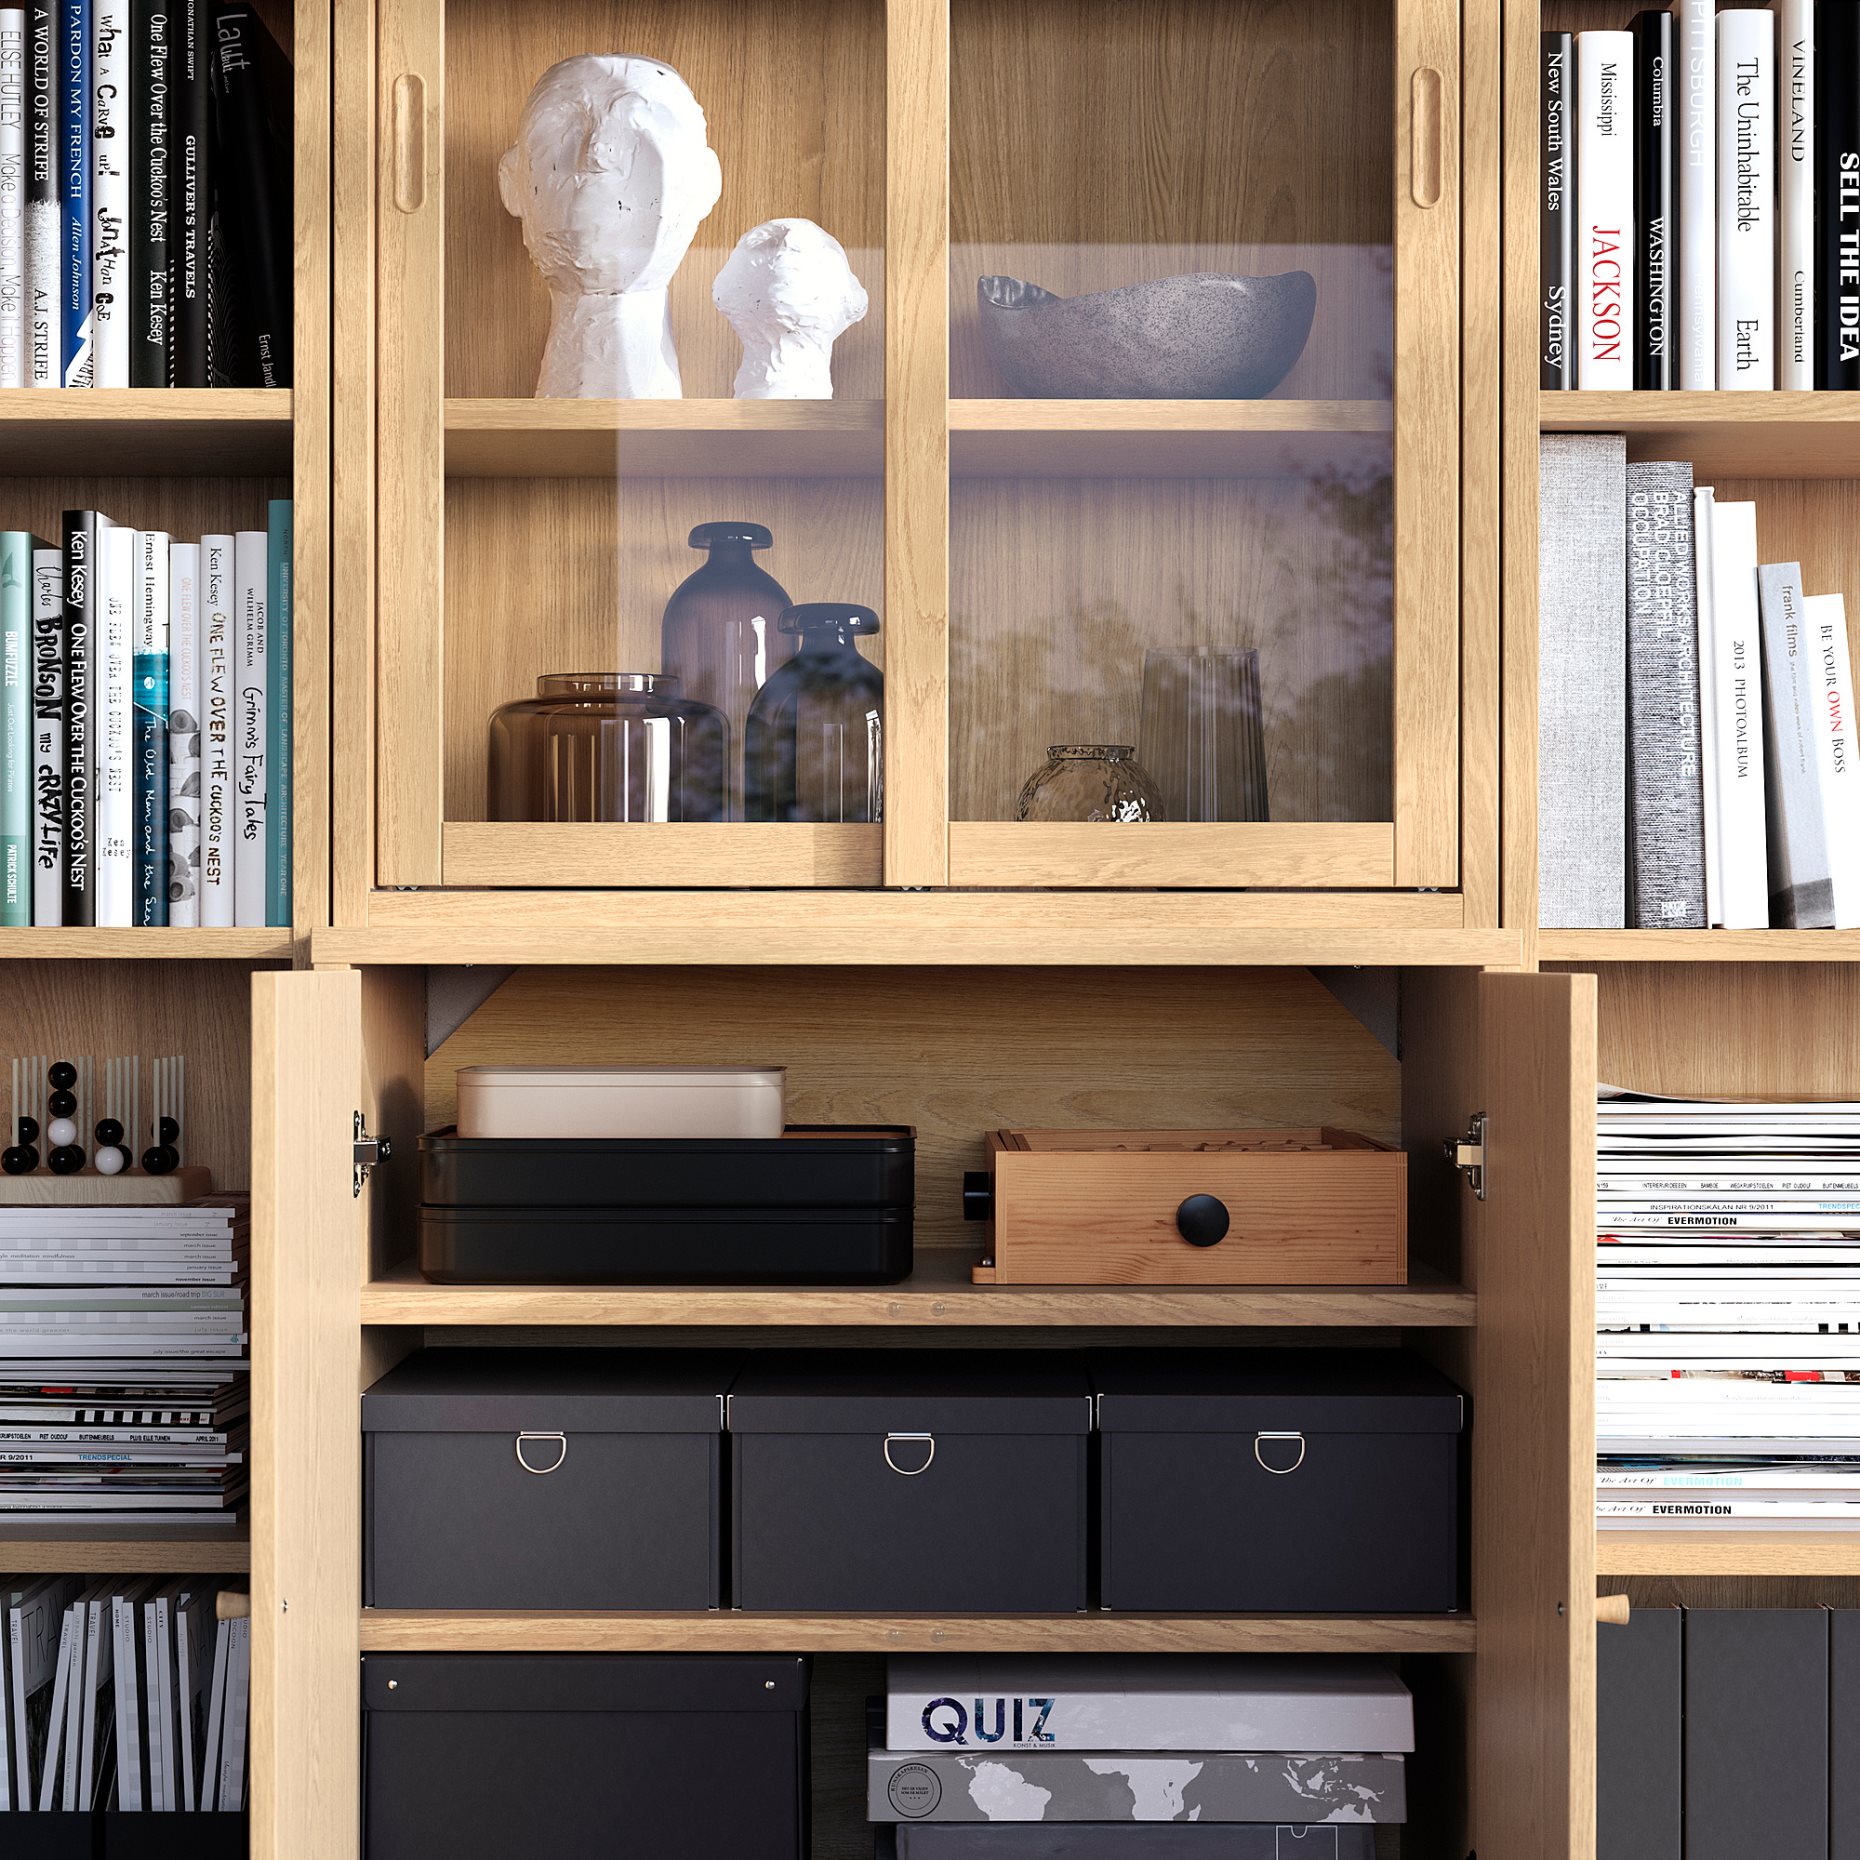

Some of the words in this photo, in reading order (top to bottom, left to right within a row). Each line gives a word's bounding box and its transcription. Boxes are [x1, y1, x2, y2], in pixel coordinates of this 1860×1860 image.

[35, 8, 48, 20] A
[151, 15, 167, 41] One
[1, 32, 22, 69] ELISE
[35, 25, 48, 89] WORLD
[71, 6, 81, 82] PARDON
[216, 14, 251, 69] Laut
[151, 45, 167, 80] Flew
[1549, 51, 1563, 96] New
[1737, 58, 1759, 95] The
[1, 72, 22, 129] HUTLEY
[151, 84, 166, 119] Over
[1597, 64, 1616, 135] Mississippi
[1651, 56, 1664, 128] Columbia
[1688, 0, 1706, 168] PITTSBURGH
[1791, 39, 1806, 162] VINELAND
[35, 95, 48, 117] OF
[71, 89, 81, 118] MY
[151, 123, 166, 143] the
[1547, 99, 1564, 152] South
[35, 123, 48, 180] STRIFE
[71, 125, 81, 198] FRENCH
[1738, 103, 1759, 231] Uninhabitable
[1, 154, 22, 191] Make
[151, 148, 168, 206] Cuckoo's
[186, 136, 195, 225] GULLIVER'S
[1547, 156, 1564, 212] Wales
[1841, 153, 1859, 221] SELL
[72, 218, 81, 251] Allen
[151, 210, 167, 242] Nest
[186, 230, 195, 298] TRAVELS
[1839, 229, 1860, 286] THE
[1, 275, 21, 311] Make
[72, 255, 81, 310] Johnson
[151, 271, 166, 298] Ken
[1593, 226, 1620, 360] JACKSON
[1648, 215, 1665, 357] WASHINGTON
[34, 288, 47, 315] A.J.
[1794, 271, 1806, 363] Cumberland
[147, 303, 166, 345] Kesey
[1543, 285, 1567, 370] Sydney
[1839, 295, 1860, 362] IDEA
[34, 322, 47, 379] STRIFE
[258, 334, 272, 360] Ernst
[1737, 320, 1759, 370] Earth
[262, 363, 277, 388] Jandl
[1653, 493, 1671, 544] BRAD
[1673, 492, 1691, 557] ALLIED
[70, 530, 87, 561] Ken
[146, 534, 154, 570] Ernest
[211, 548, 221, 570] Ken
[1631, 493, 1651, 614] OCCUPATION
[66, 563, 88, 610] Kesey
[207, 574, 221, 605] Kesey
[1675, 562, 1692, 627] WORKS
[1783, 586, 1795, 619] frank
[143, 577, 154, 646] Hemingway
[210, 613, 226, 643] ONE
[1786, 624, 1798, 657] films
[1821, 626, 1832, 639] BE
[3, 630, 16, 687] BUMFUZZLE
[210, 649, 224, 692] FLEW
[1734, 641, 1745, 669] 2013
[1823, 646, 1836, 686] YOUR
[6, 702, 14, 718] Just
[210, 697, 226, 742] OVER
[1677, 632, 1696, 776] ARCHITECTURE
[1828, 691, 1842, 731] OWN
[6, 719, 16, 732] Out
[40, 733, 51, 752] my
[142, 715, 158, 741] The
[1735, 680, 1748, 777] PHOTOALBUM
[5, 733, 14, 758] Looking
[6, 758, 15, 769] for
[69, 743, 84, 774] THE
[1832, 739, 1845, 772] BOSS
[6, 769, 14, 793] Pirates
[143, 748, 156, 781] Old
[212, 749, 227, 780] THE
[239, 755, 263, 794] Fairy
[144, 790, 155, 821] Man
[244, 793, 268, 841] Tales
[5, 843, 16, 874] PATRICK
[145, 826, 155, 855] and
[144, 865, 154, 888] the
[207, 848, 220, 885] NEST
[5, 874, 16, 904] SCHULTE
[142, 898, 160, 928] Sea
[1668, 1217, 1736, 1225] EVERMOTION
[8, 1454, 33, 1462] 9/2011
[1664, 1476, 1742, 1486] EVERMOTION
[1653, 1505, 1732, 1514] EVERMOTION
[921, 1697, 1056, 1746] QUIZ
